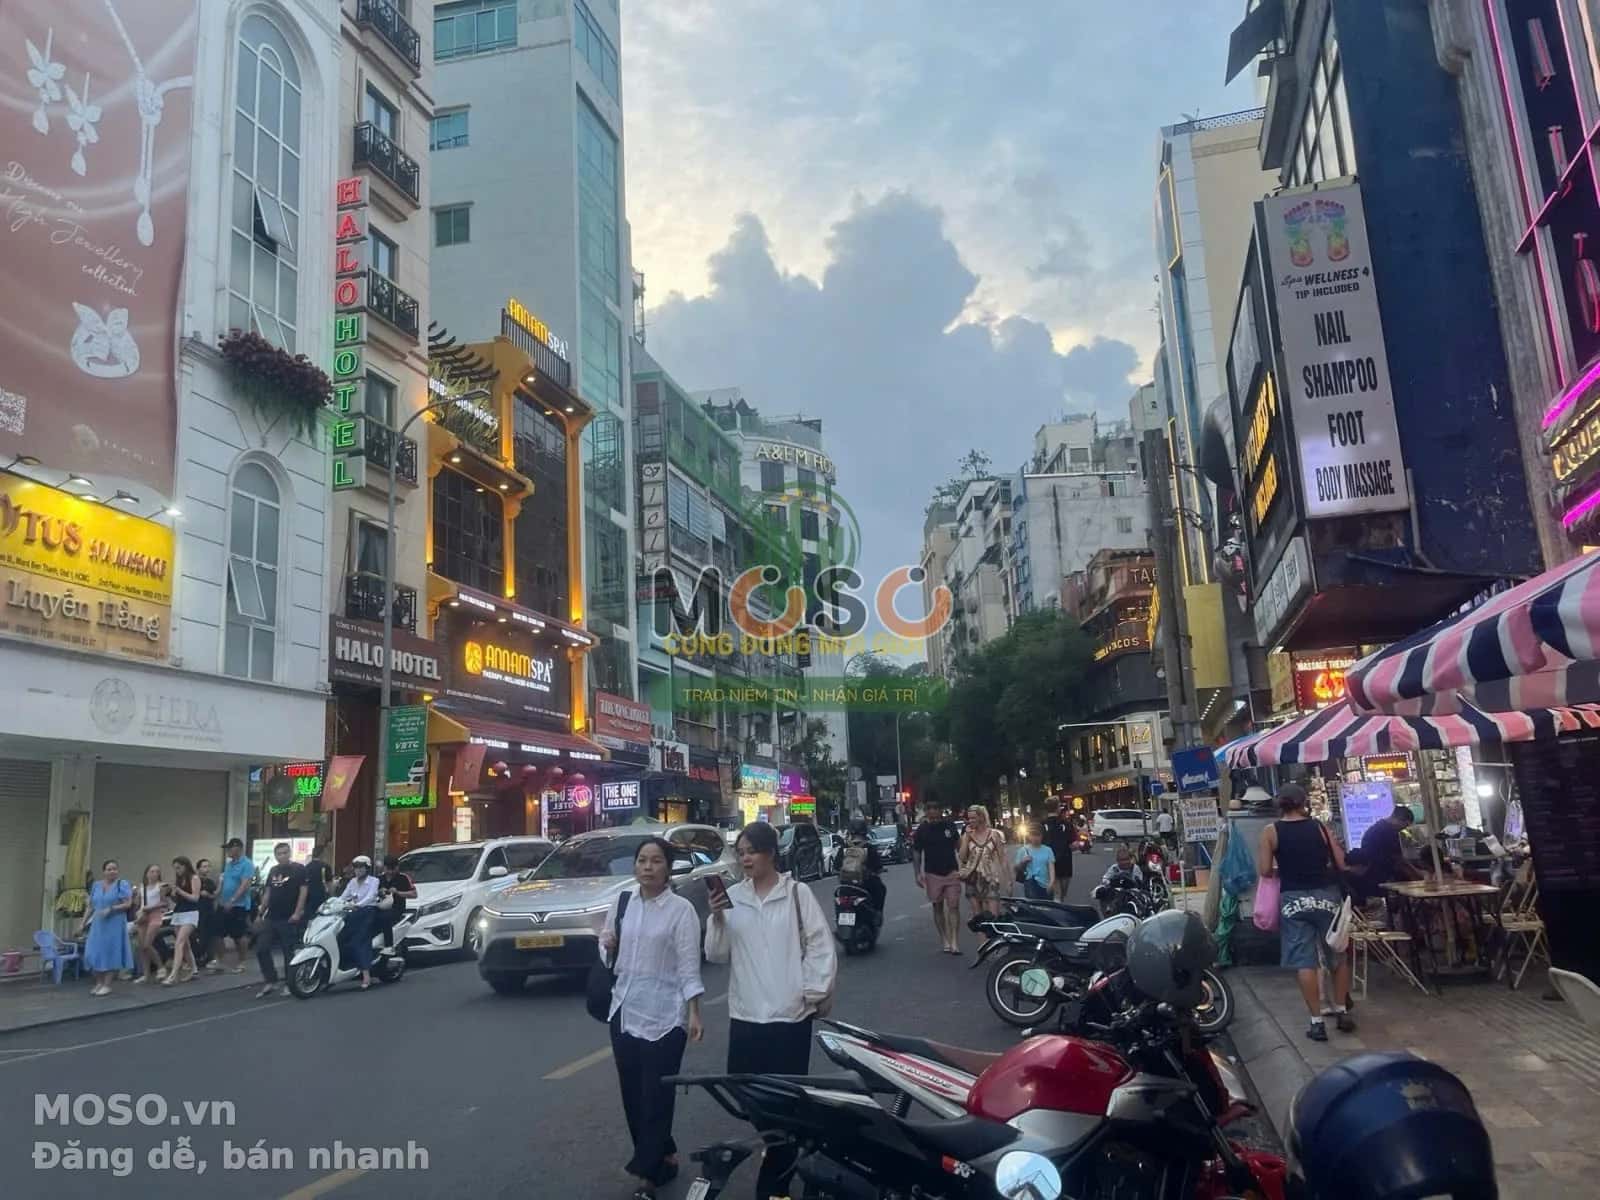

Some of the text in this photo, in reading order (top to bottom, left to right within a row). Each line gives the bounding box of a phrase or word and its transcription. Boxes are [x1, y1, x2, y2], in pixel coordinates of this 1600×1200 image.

[81, 264, 138, 297] collection
[1296, 281, 1360, 300] TIP INCLUDED
[1305, 267, 1360, 286] WELLNESS
[1314, 309, 1352, 346] NAIL
[1303, 356, 1378, 400] SHAMPOO
[333, 315, 360, 486] HOTEL
[1327, 409, 1366, 448] FOOT
[1316, 464, 1342, 502] BODY
[1345, 459, 1395, 499] MASSAGE
[114, 548, 167, 581] MASSAGE
[336, 636, 441, 680] HALO HOTEL
[144, 694, 221, 732] HERA
[605, 784, 637, 799] THE ONE
[608, 798, 634, 807] HOTEL
